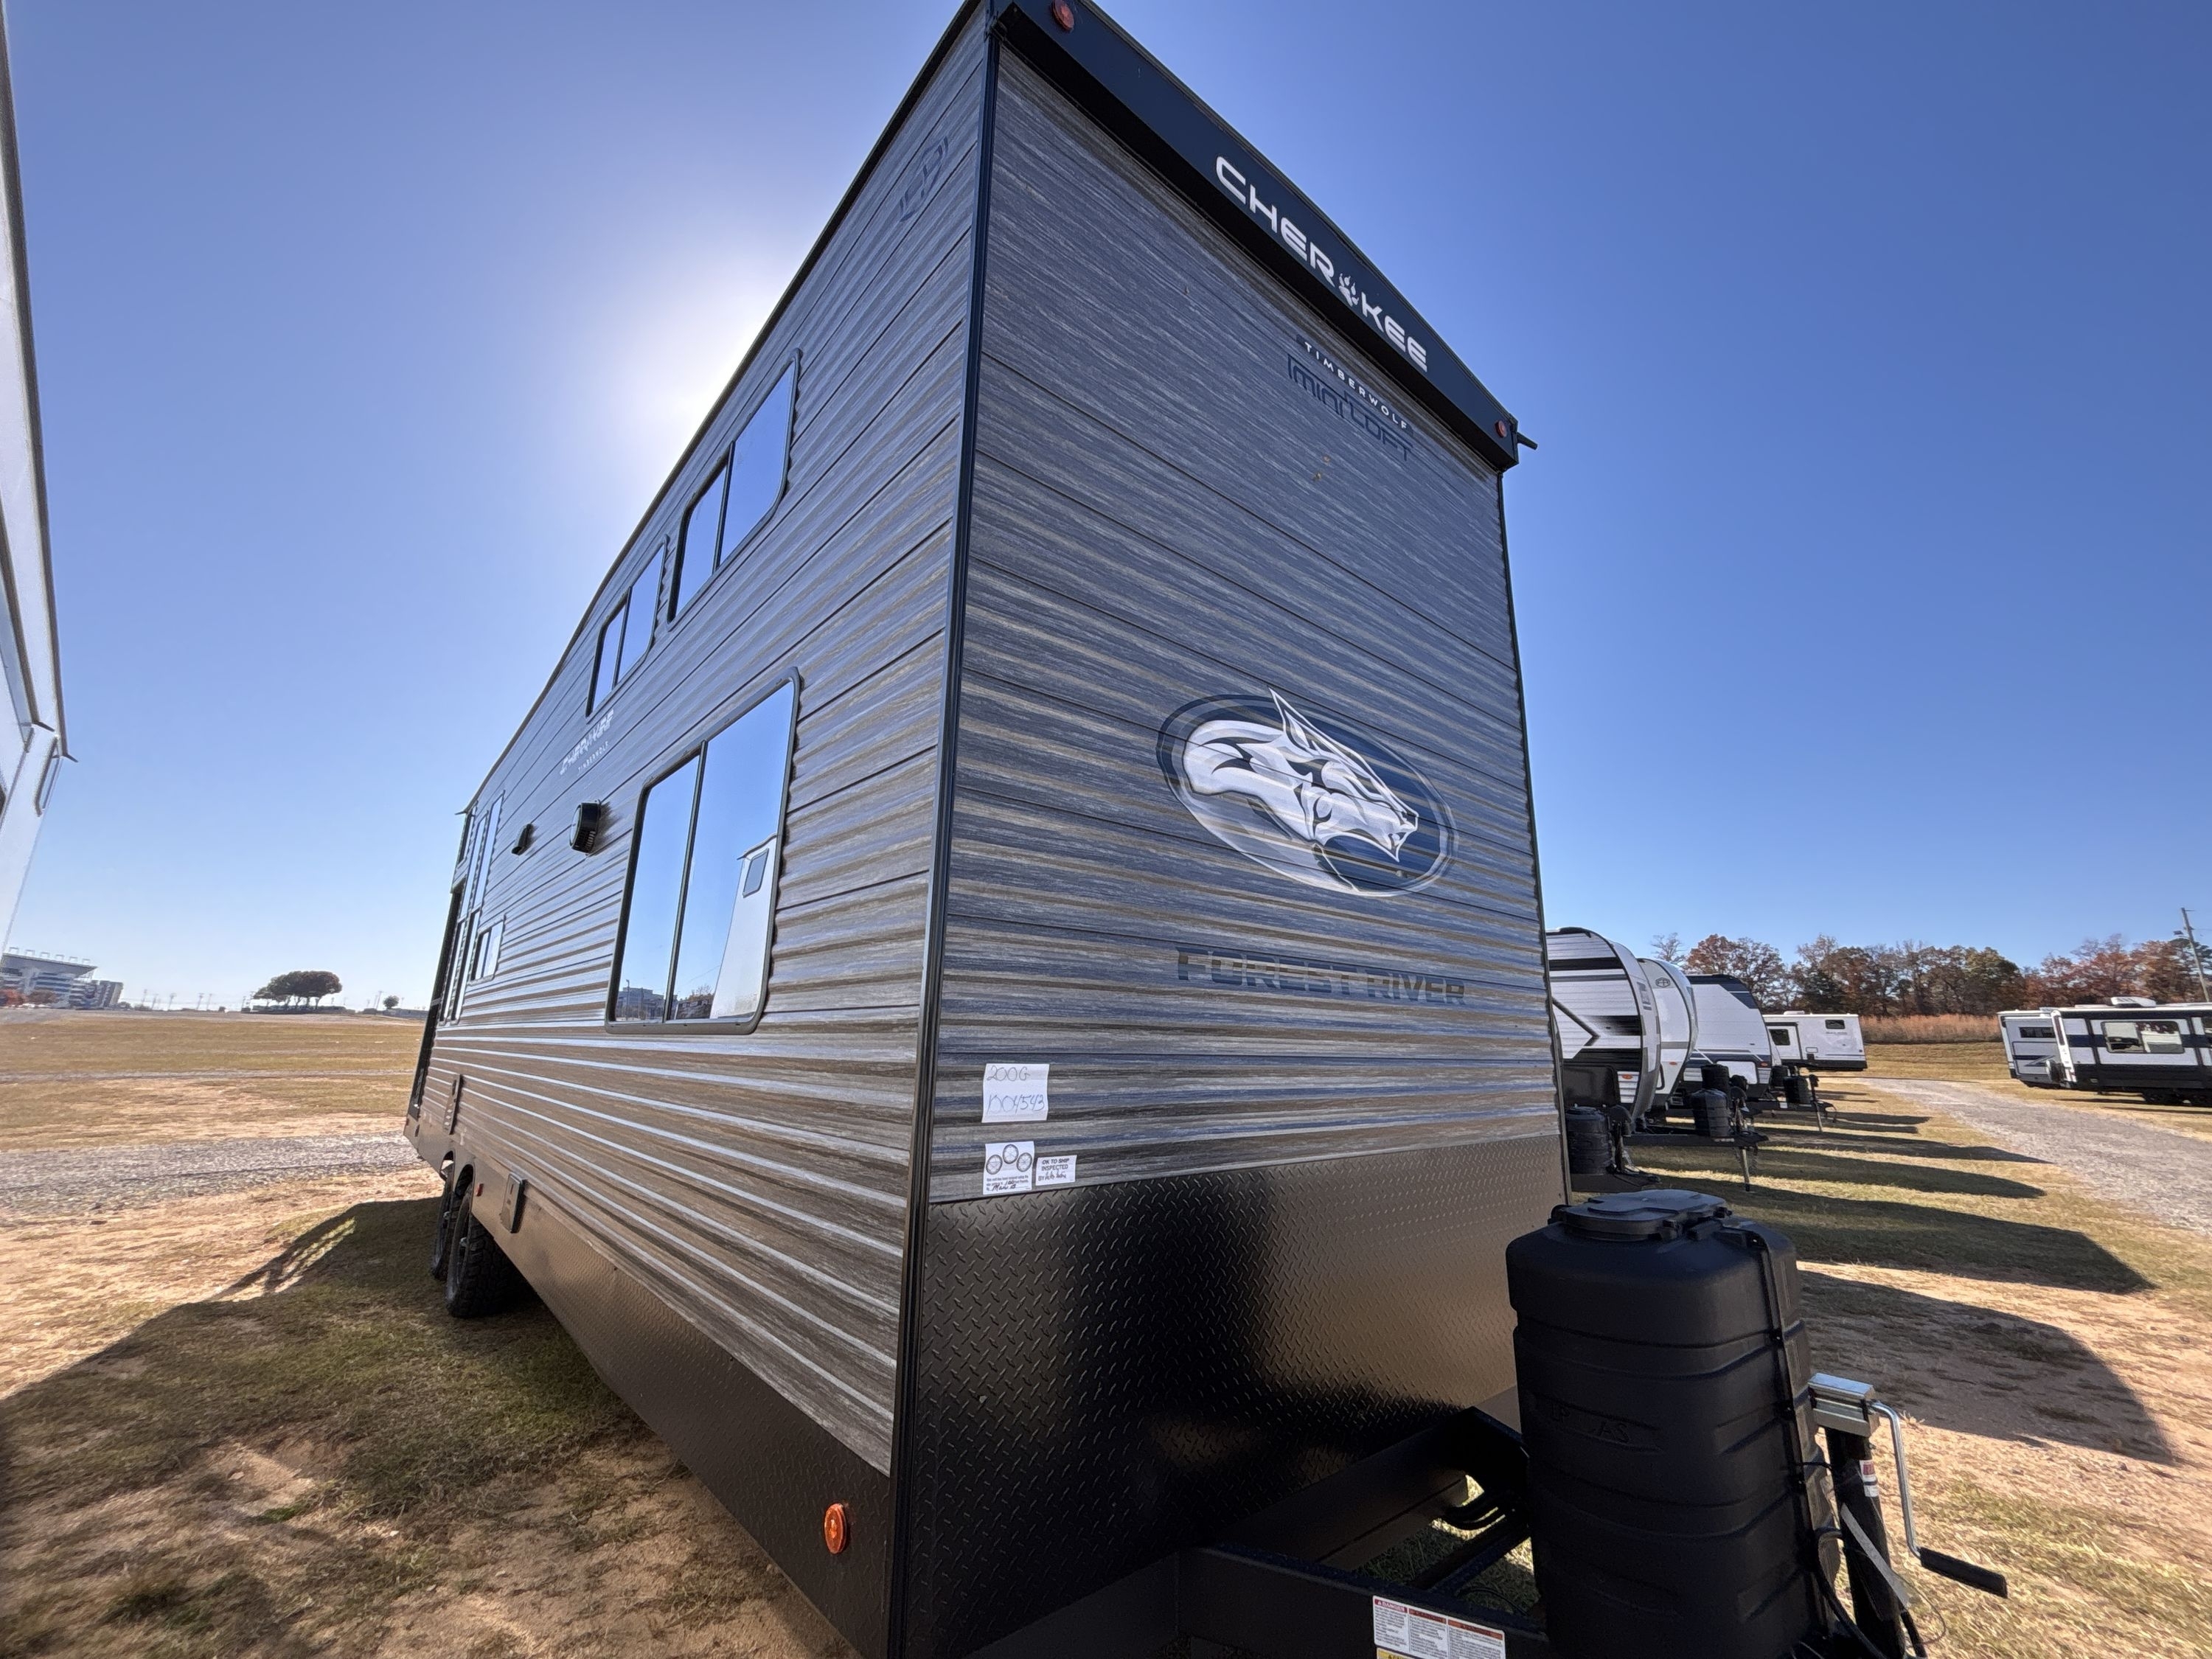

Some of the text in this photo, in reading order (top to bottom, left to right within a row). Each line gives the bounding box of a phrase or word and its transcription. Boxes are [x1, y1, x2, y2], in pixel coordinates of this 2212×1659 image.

[1304, 341, 1407, 429] TIMBERWOLF
[1175, 946, 1466, 1005] FOREST RIVER
